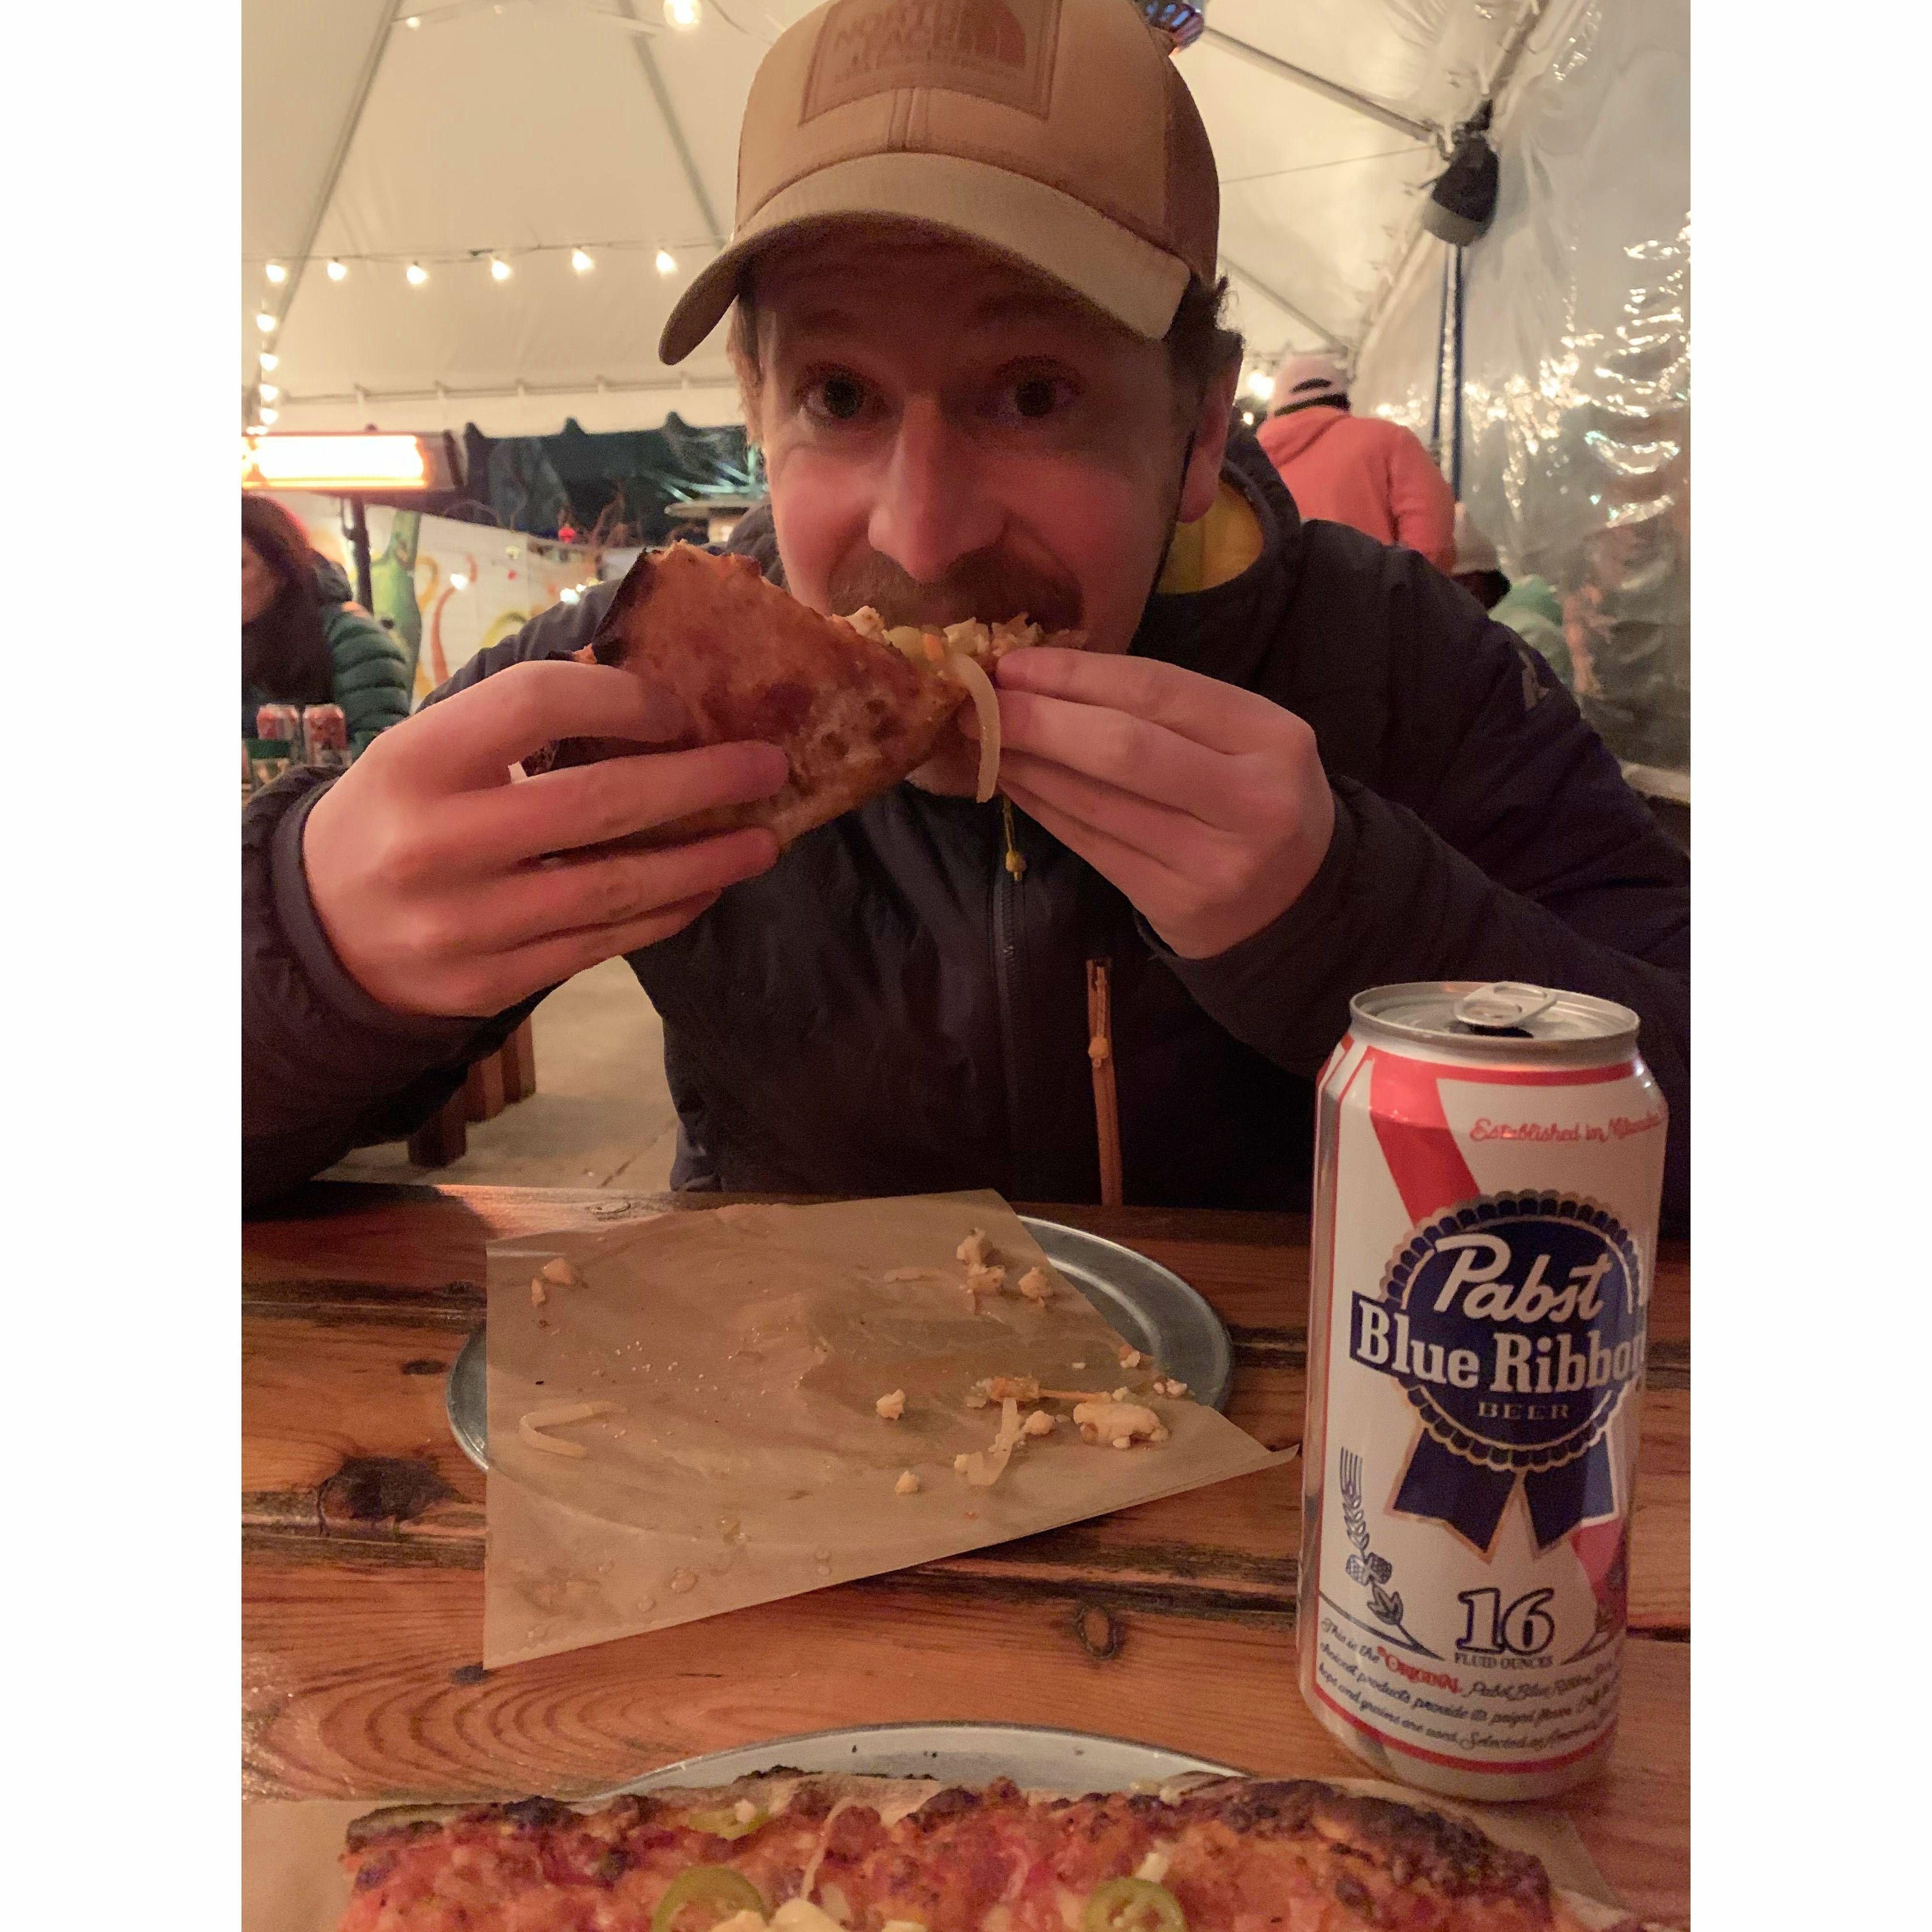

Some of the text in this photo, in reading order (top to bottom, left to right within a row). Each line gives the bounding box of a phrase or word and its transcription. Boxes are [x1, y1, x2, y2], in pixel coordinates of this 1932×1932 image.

[1469, 1117, 1579, 1142] Established
[1434, 1233, 1612, 1322] Pabst
[1357, 1300, 1479, 1389] Blue
[1477, 1402, 1569, 1420] BEER
[1457, 1587, 1554, 1655] 16
[1454, 1652, 1553, 1669] FLUID OUNCES
